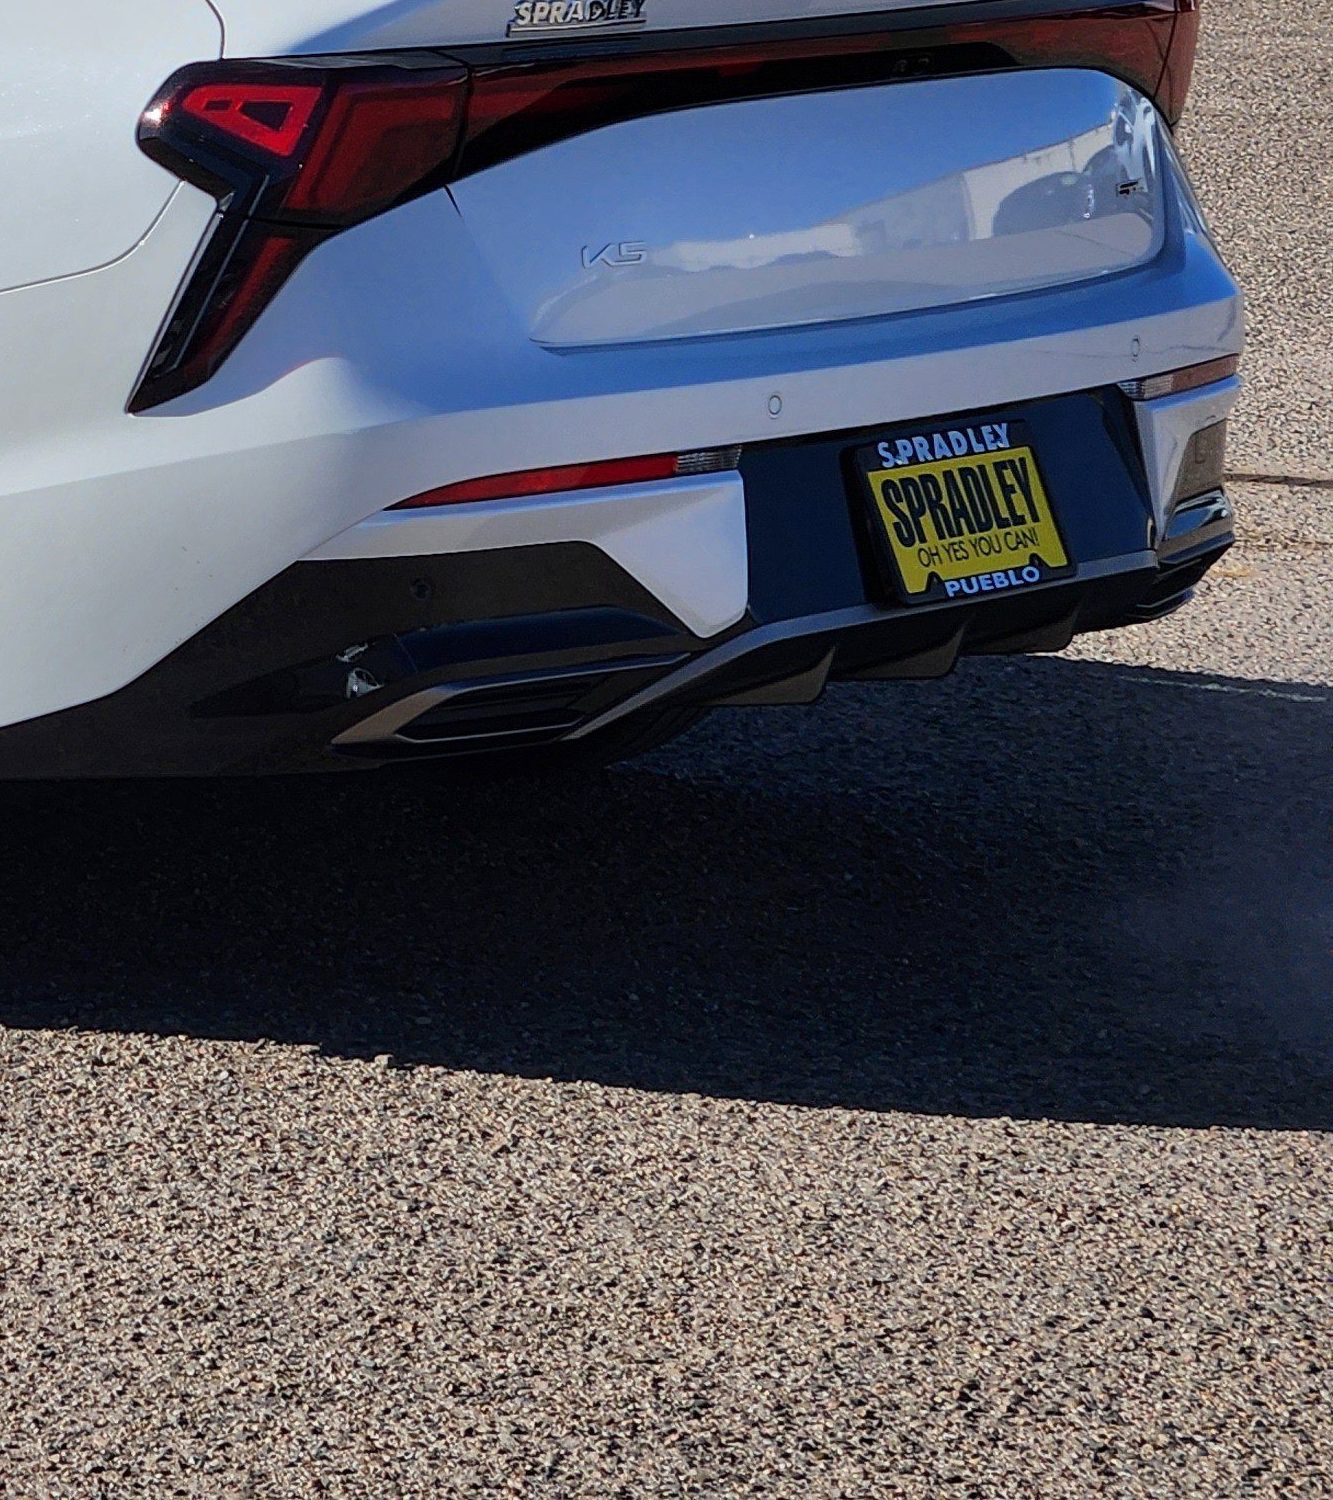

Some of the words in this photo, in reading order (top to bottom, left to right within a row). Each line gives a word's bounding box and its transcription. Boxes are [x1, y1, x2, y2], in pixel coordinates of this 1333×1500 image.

[581, 240, 647, 269] K5
[877, 422, 1011, 468] SPRADLEY
[880, 456, 1041, 548] SPRADLEY
[917, 545, 944, 568] OH
[945, 539, 970, 562] YES
[971, 533, 1003, 558] YOU
[1003, 527, 1040, 551] CAN!
[944, 566, 1041, 598] PUEBLO
